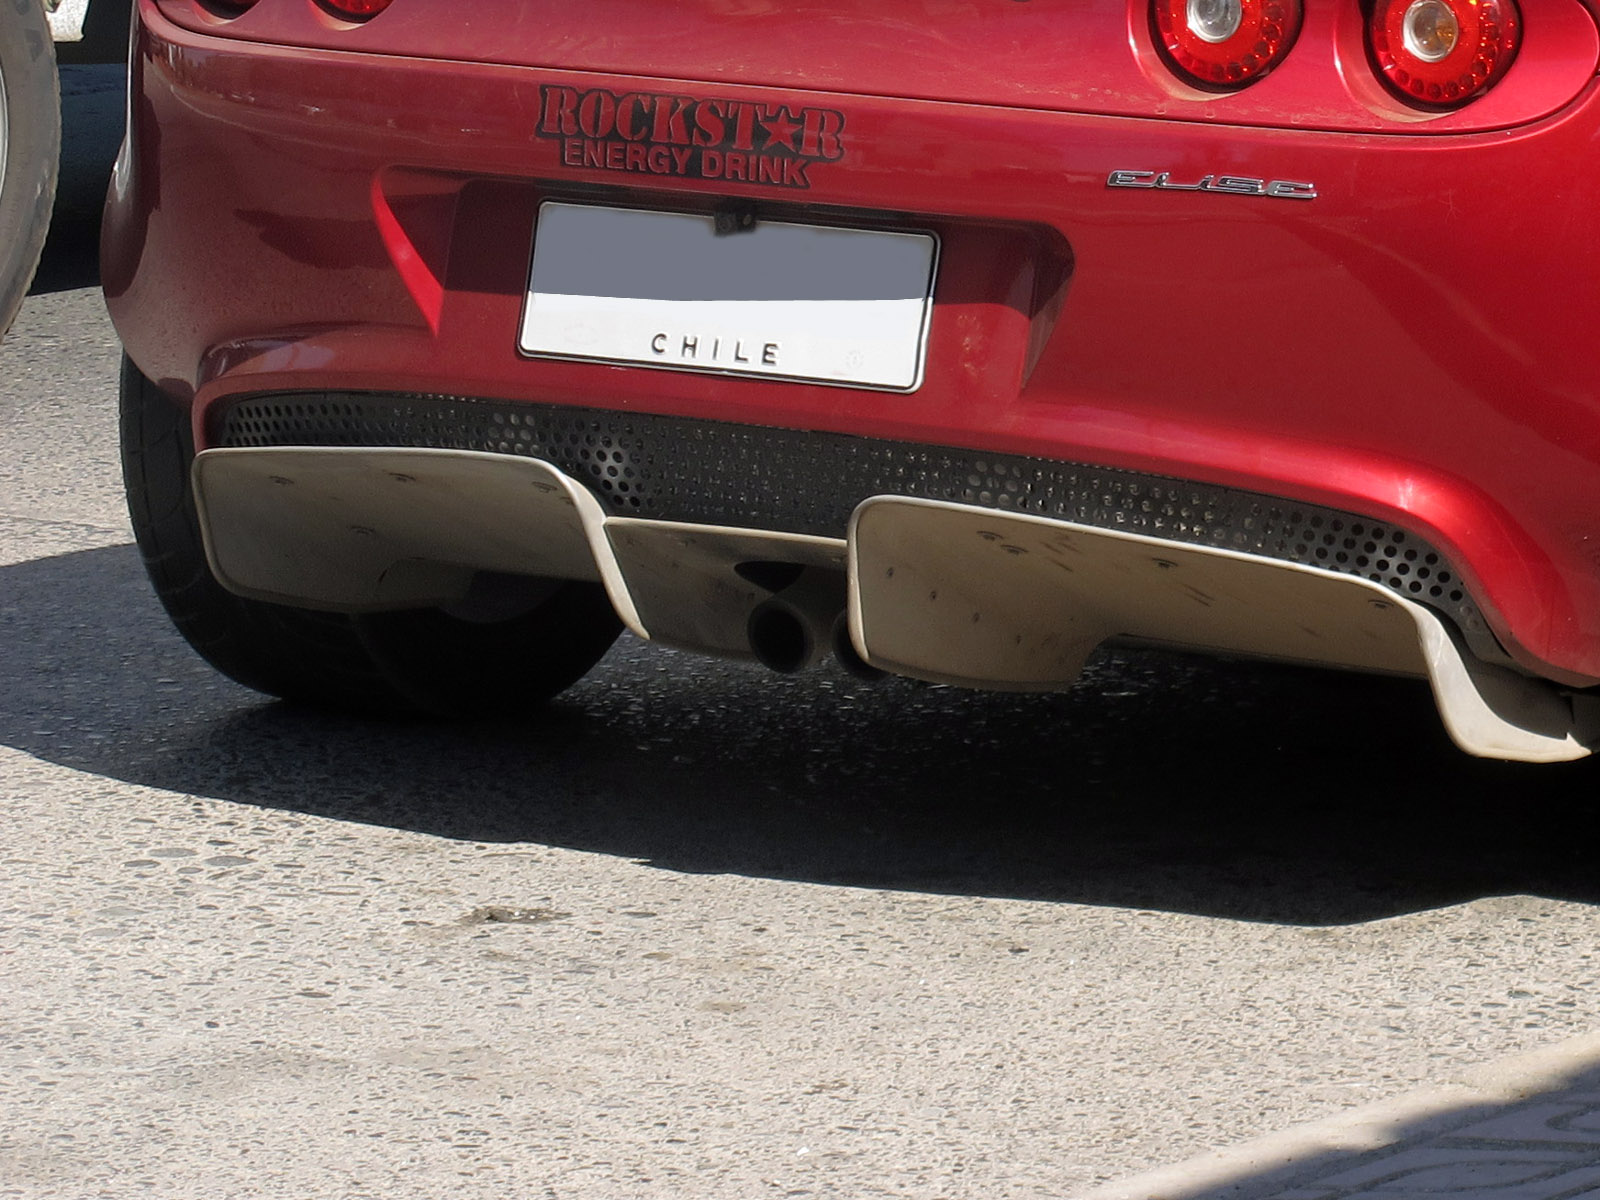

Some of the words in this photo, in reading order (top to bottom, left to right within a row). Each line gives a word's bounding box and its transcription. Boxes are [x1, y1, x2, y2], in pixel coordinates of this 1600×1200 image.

[563, 137, 694, 175] ENERGY
[701, 150, 811, 187] DRINK
[651, 333, 779, 365] CHILE
